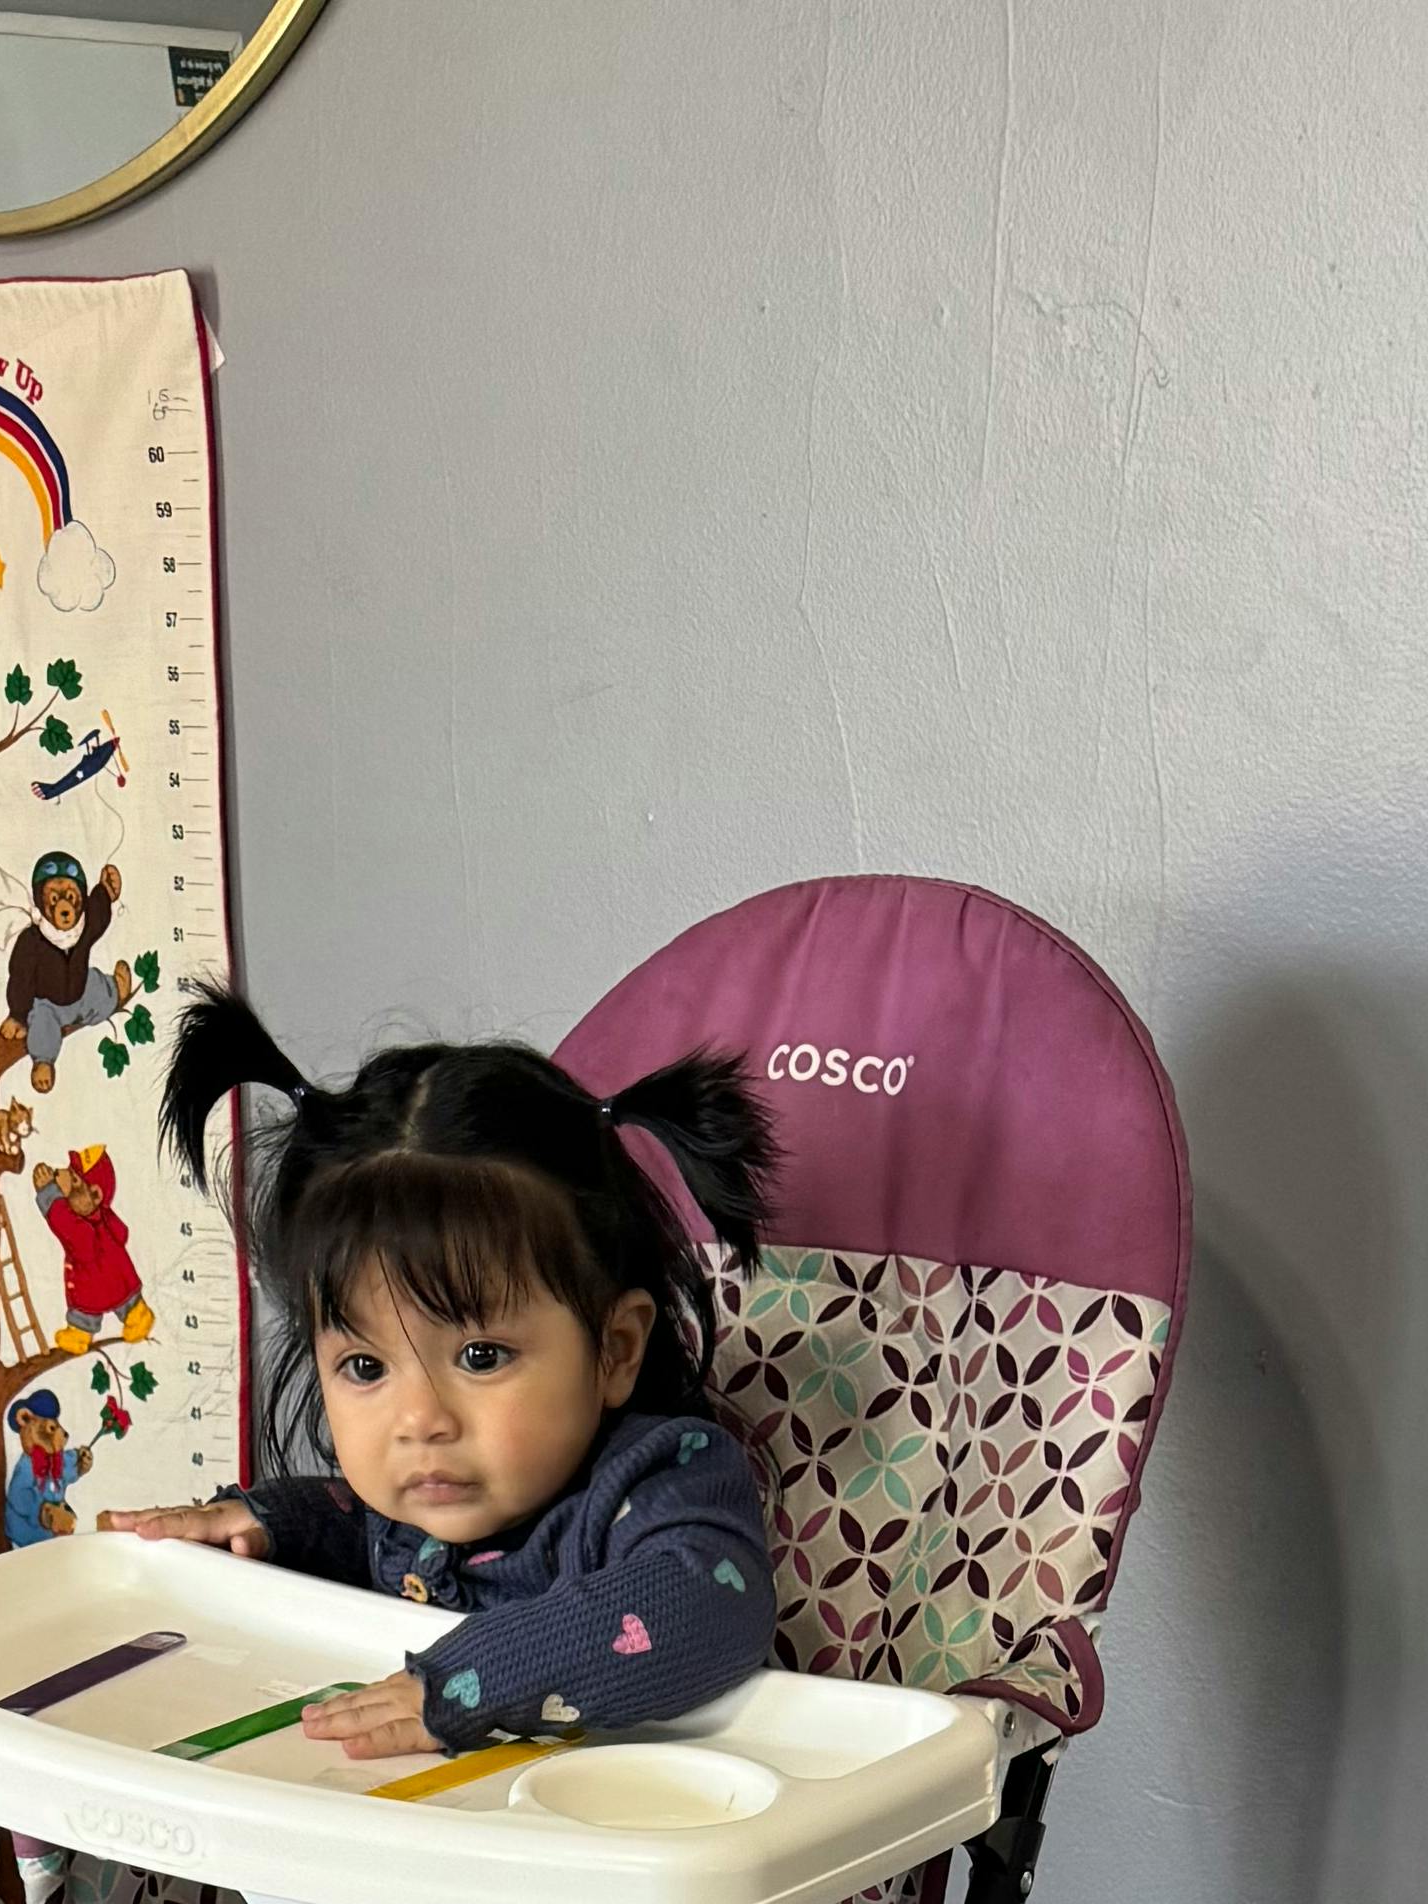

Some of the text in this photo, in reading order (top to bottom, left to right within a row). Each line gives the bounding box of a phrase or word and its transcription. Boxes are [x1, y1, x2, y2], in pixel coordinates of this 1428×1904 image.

[14, 357, 44, 406] Up
[148, 446, 165, 463] 60
[156, 502, 173, 518] 59
[163, 557, 176, 573] 58
[166, 612, 178, 627] 57
[169, 719, 181, 735] 55
[169, 772, 180, 788] 54
[172, 824, 184, 840] 53
[174, 875, 184, 891] 52
[173, 927, 184, 942] 51
[767, 1043, 907, 1096] COSCO
[180, 1222, 193, 1237] 45
[182, 1269, 195, 1284] 44
[185, 1315, 199, 1329] 43
[188, 1361, 201, 1375] 42
[190, 1407, 202, 1420] 41
[191, 1452, 203, 1466] 40
